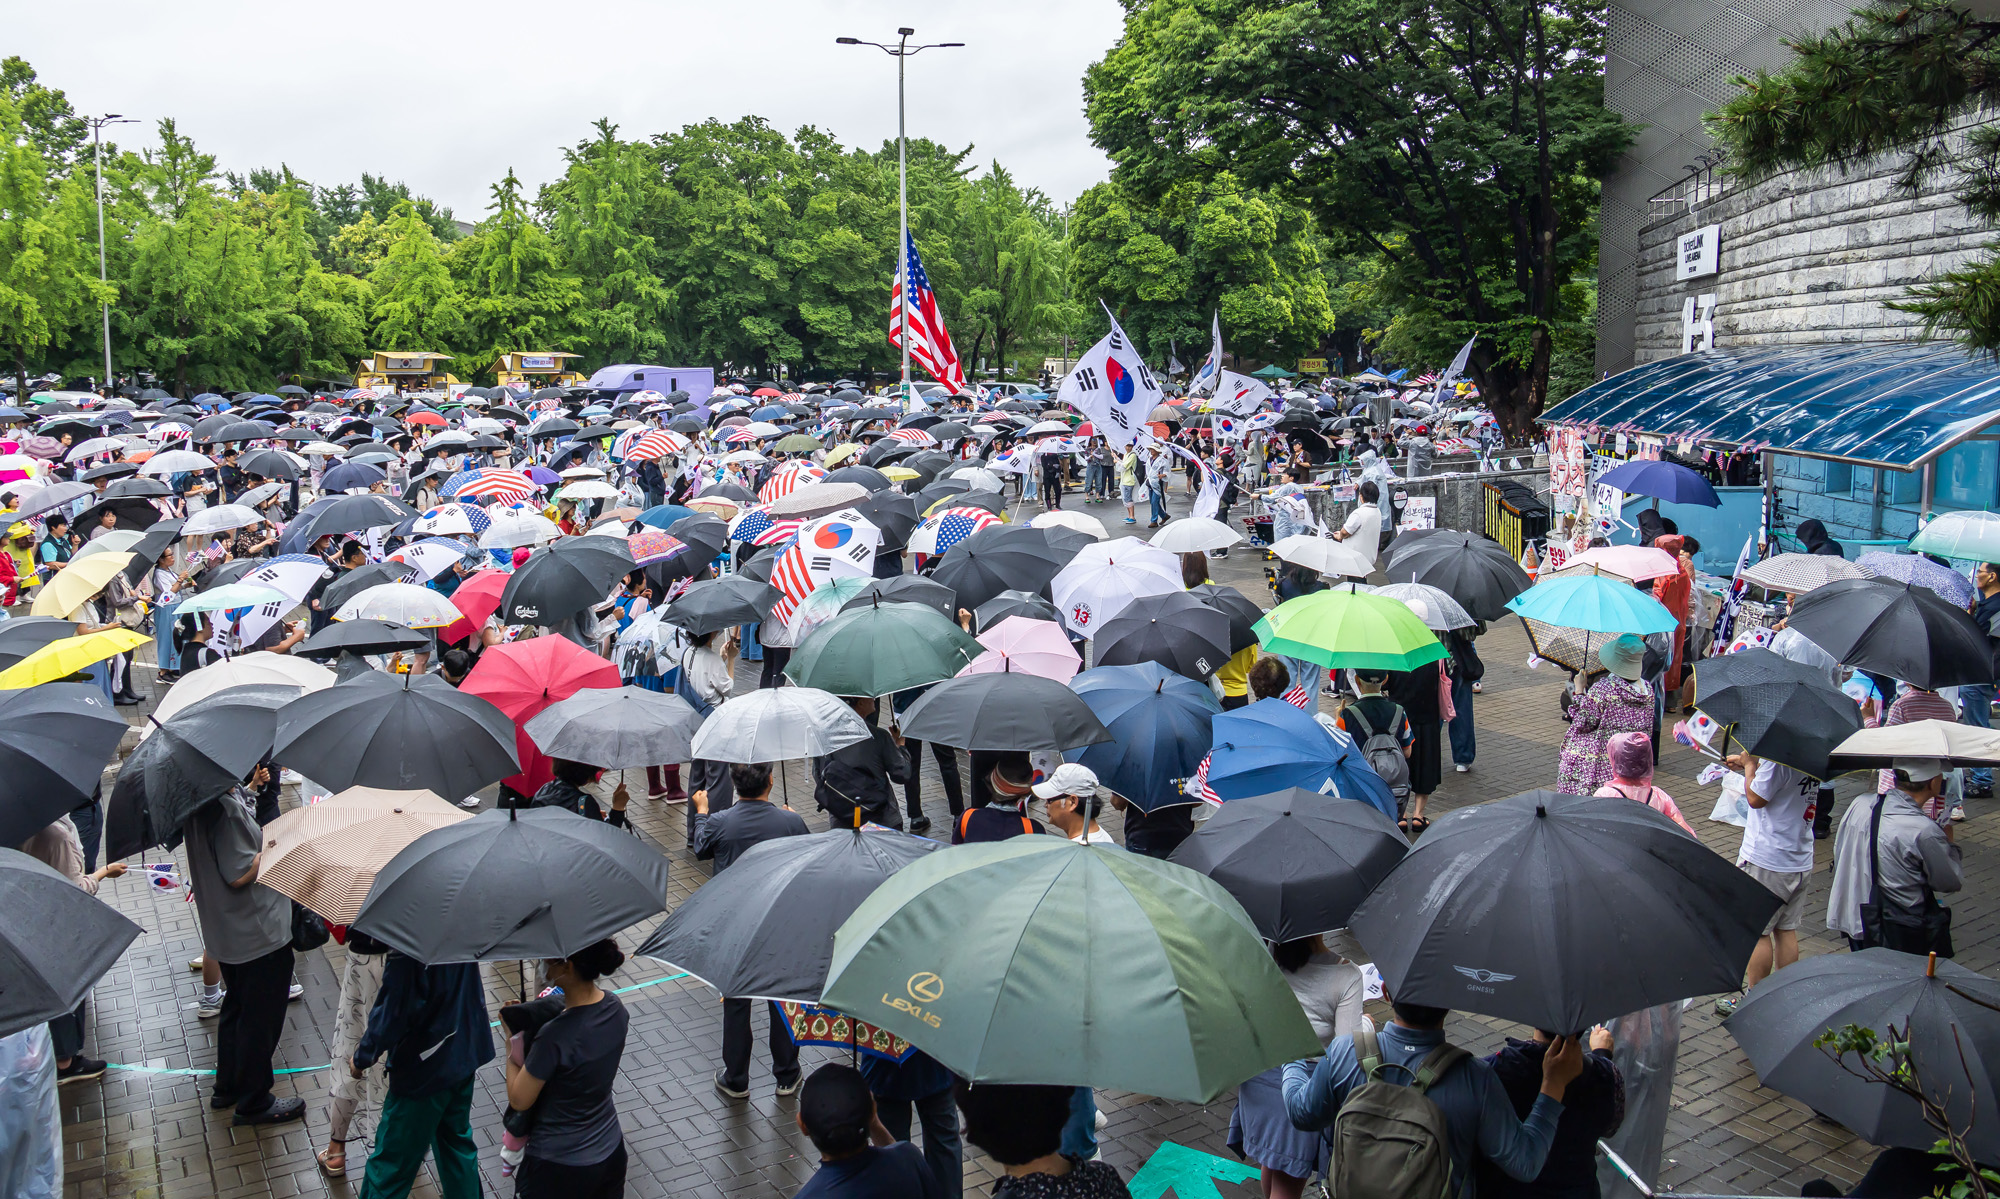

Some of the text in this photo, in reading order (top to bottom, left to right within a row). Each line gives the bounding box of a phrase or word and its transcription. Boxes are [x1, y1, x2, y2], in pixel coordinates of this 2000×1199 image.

[514, 605, 539, 619] Carlsberg
[1073, 608, 1089, 624] 13
[1466, 983, 1495, 994] GENESIS
[881, 993, 942, 1028] LEXUS
